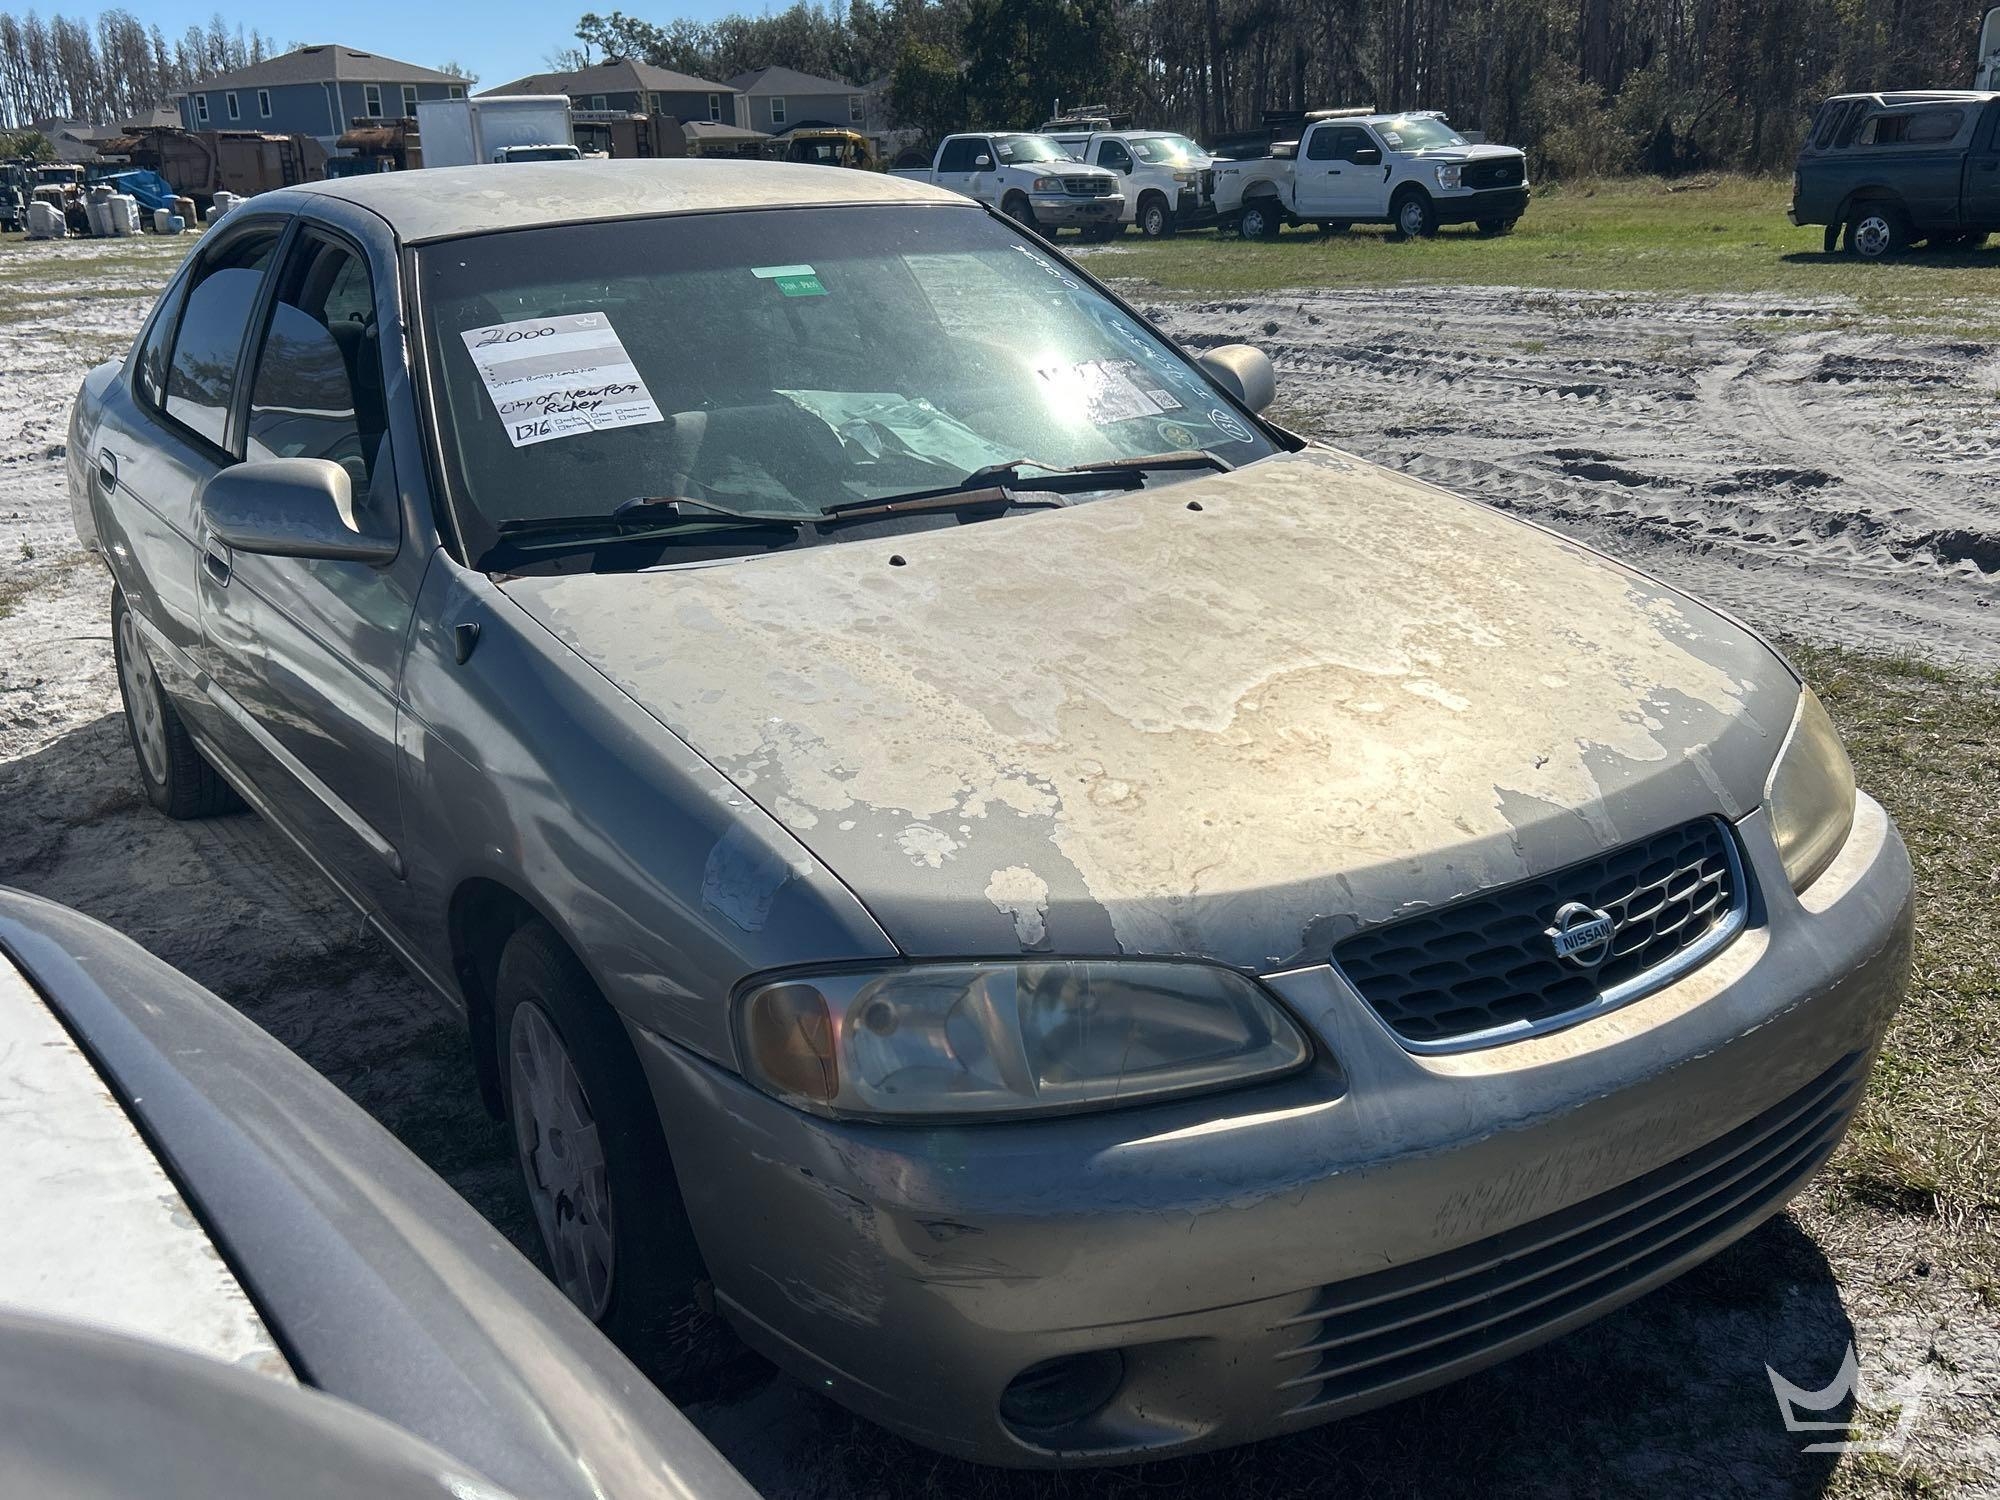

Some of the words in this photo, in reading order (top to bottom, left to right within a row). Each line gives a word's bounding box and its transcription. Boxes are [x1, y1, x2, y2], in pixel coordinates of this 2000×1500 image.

[475, 327, 555, 348] 2000
[543, 400, 603, 415] Richey
[1562, 922, 1611, 951] NISSAN
